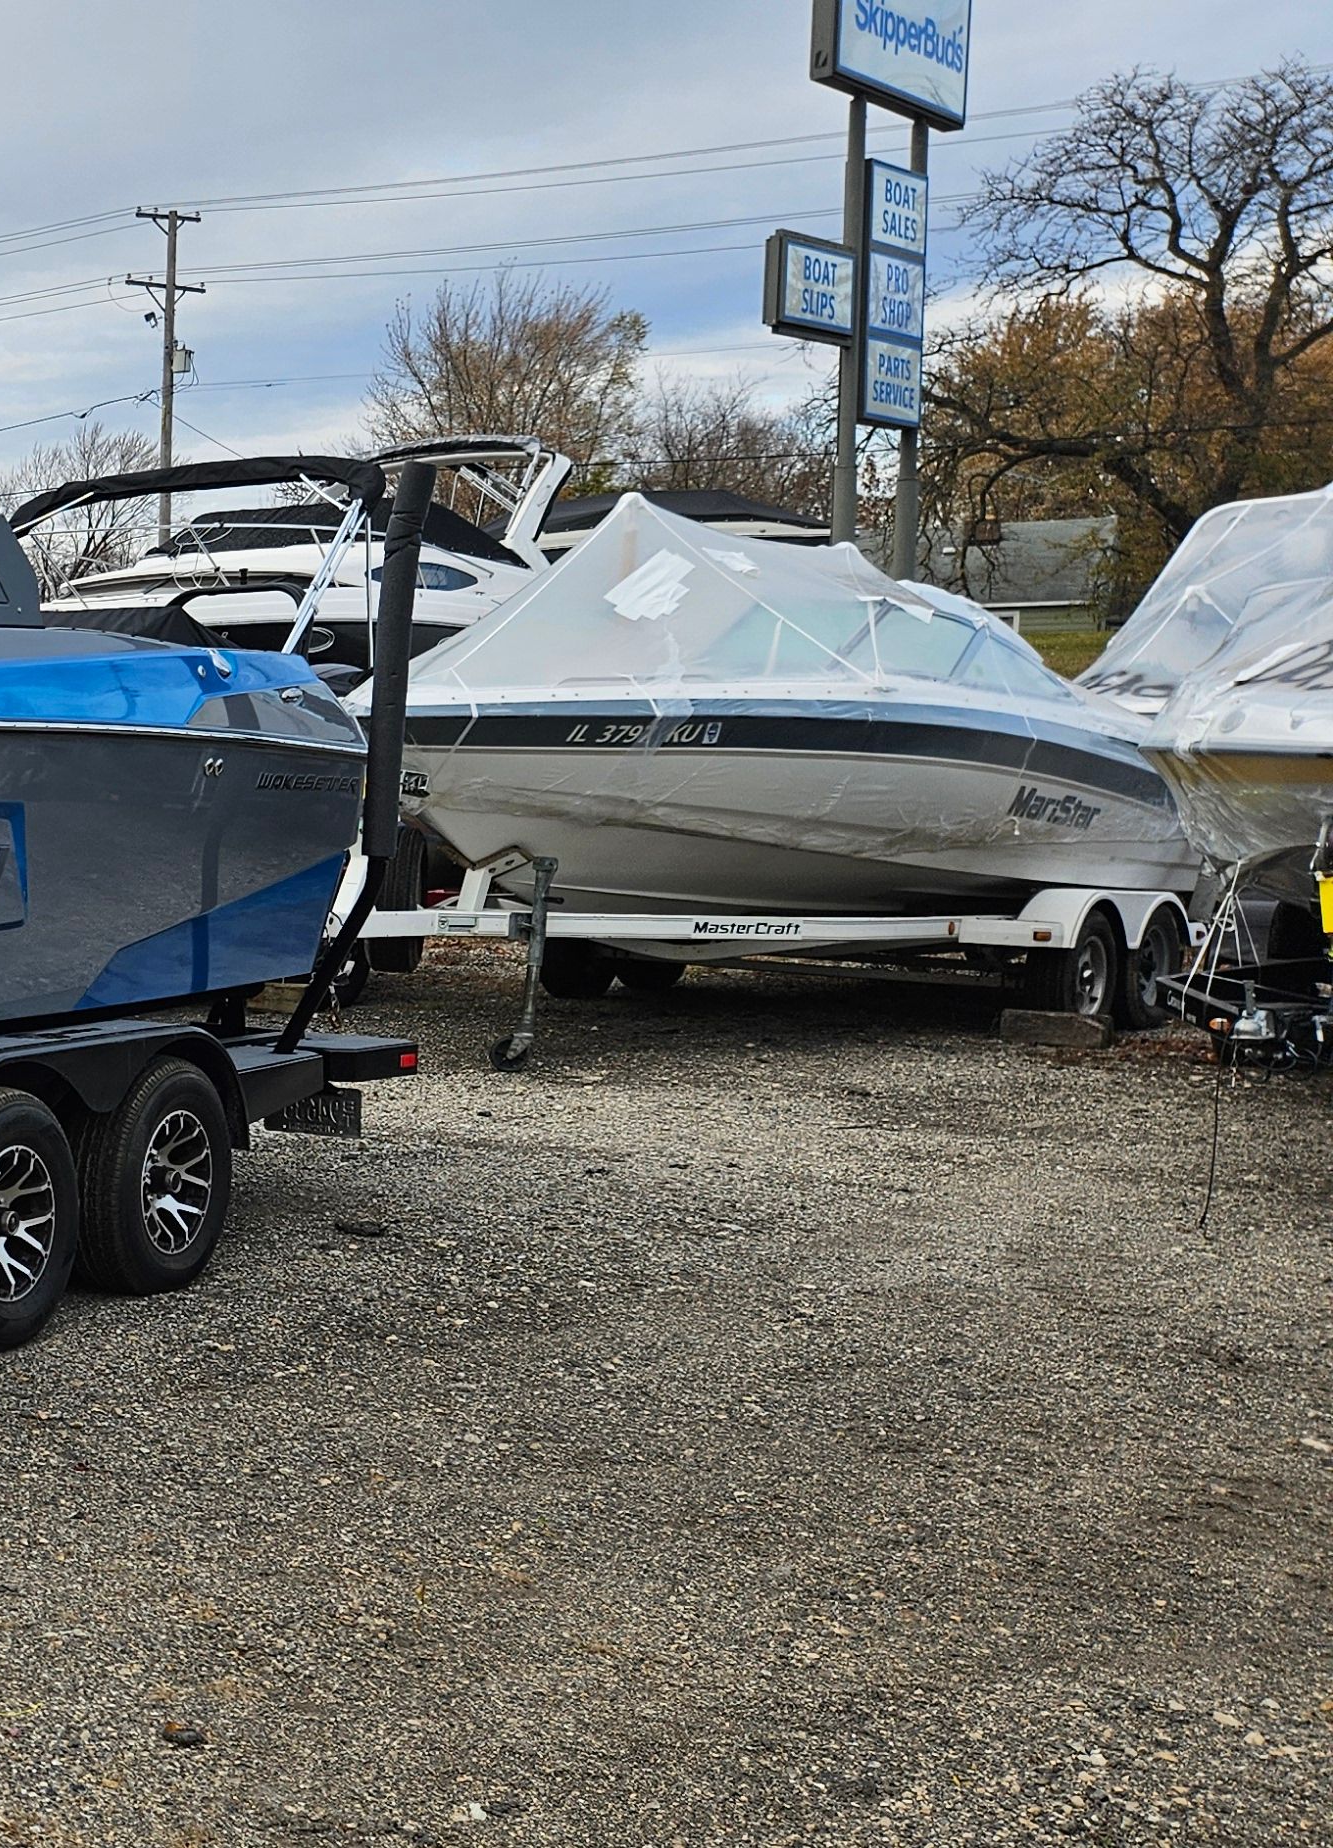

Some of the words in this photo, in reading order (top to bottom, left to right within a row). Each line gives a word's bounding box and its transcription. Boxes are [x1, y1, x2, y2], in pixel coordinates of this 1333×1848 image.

[885, 178, 917, 212] BOAT
[882, 209, 917, 242] SALES
[803, 255, 838, 288] BOAT
[886, 263, 909, 295] PRO
[801, 288, 836, 321] SLIPS
[881, 296, 912, 330] SHOP
[878, 353, 911, 381] PARTS
[872, 380, 914, 410] SERVICE
[565, 724, 589, 743] IL
[666, 724, 704, 743] KU
[693, 921, 801, 935] MasterCraft
